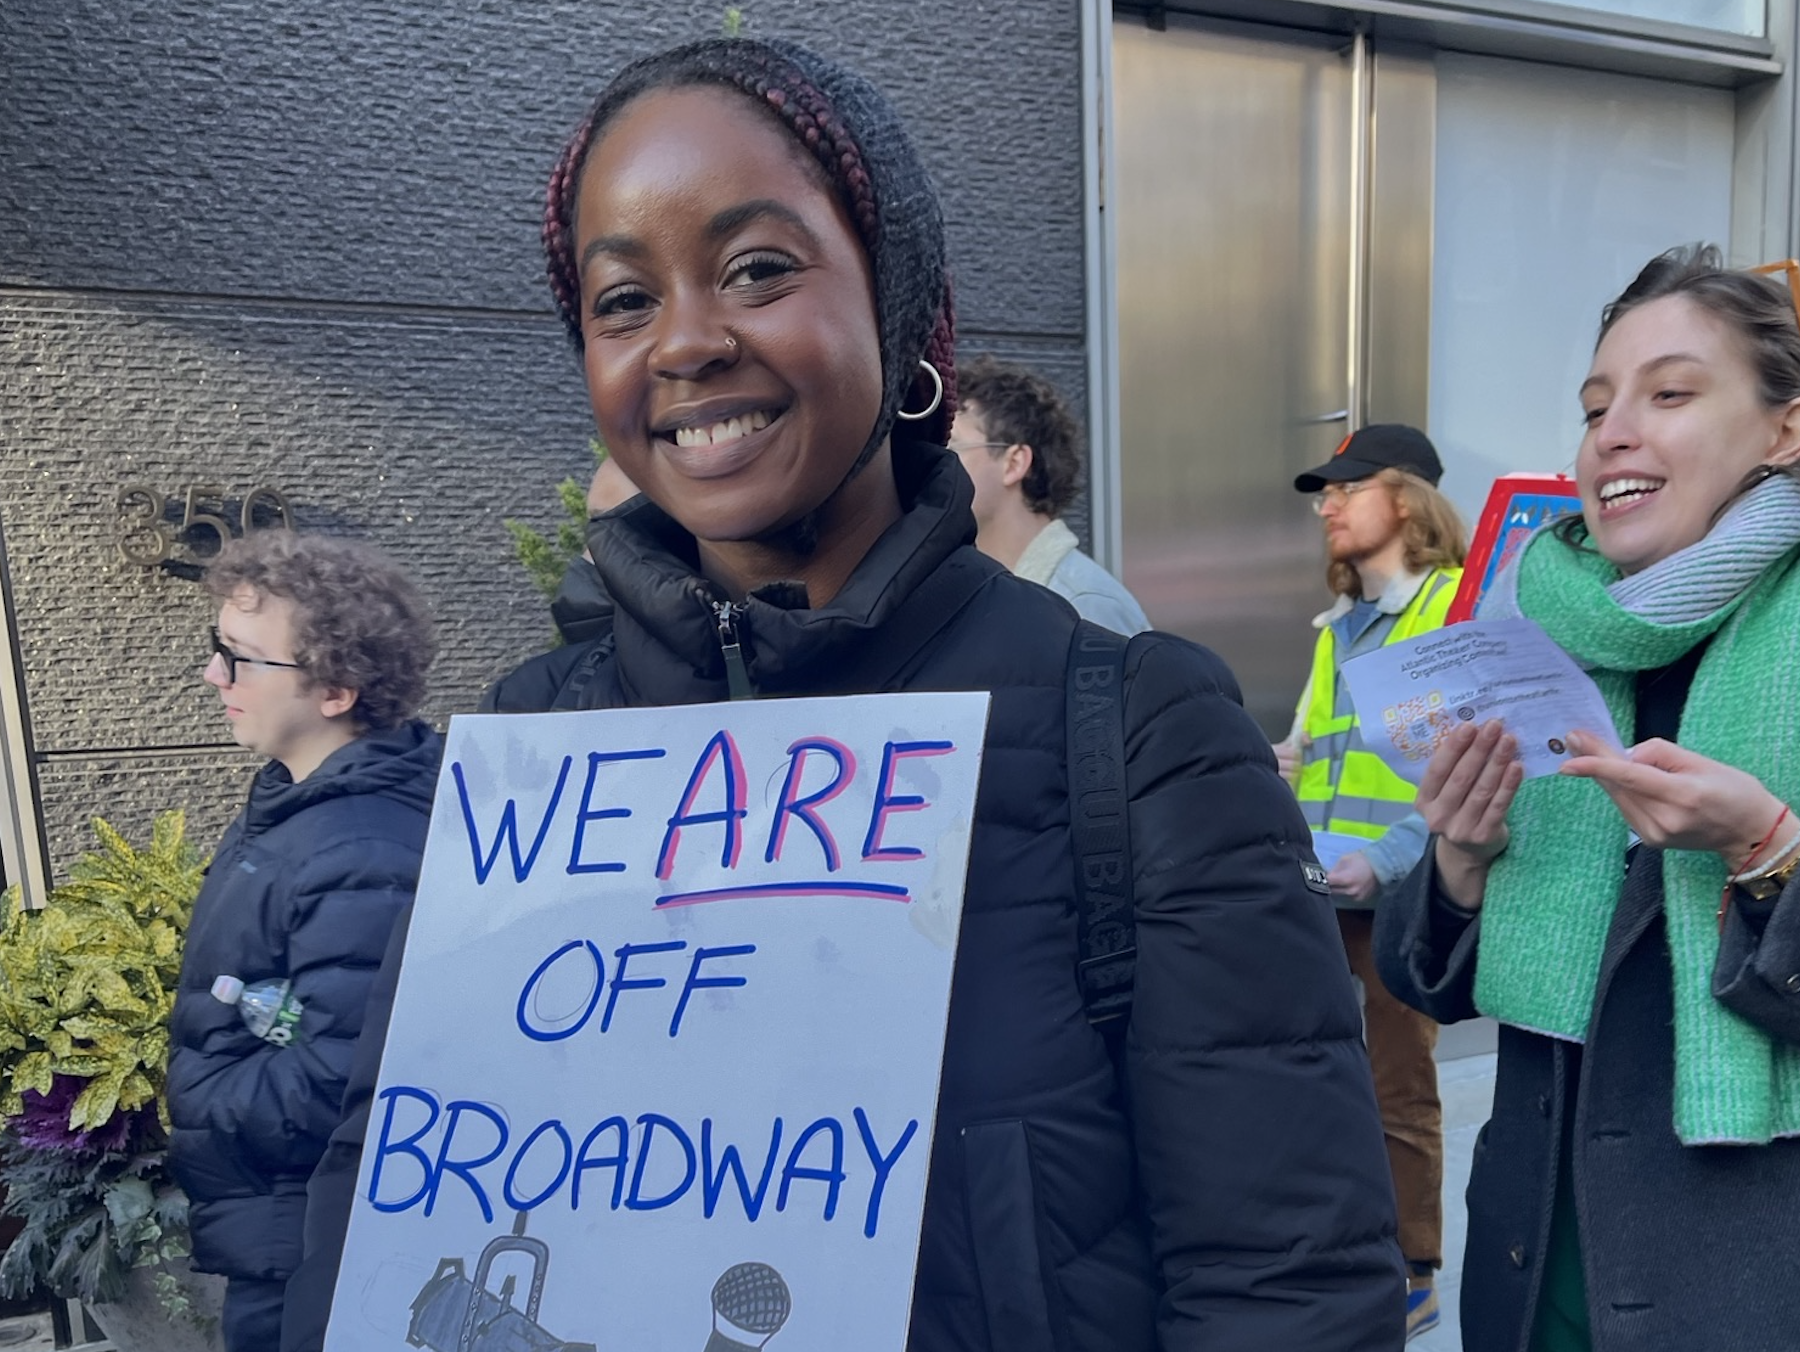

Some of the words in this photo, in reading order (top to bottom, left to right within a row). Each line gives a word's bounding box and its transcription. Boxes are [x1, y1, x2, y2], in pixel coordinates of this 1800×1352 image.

[1400, 655, 1437, 672] Atlantic
[1410, 658, 1463, 680] Organizing
[451, 747, 666, 885] WE
[654, 729, 957, 881] ARE
[1073, 665, 1122, 828] BAGGU
[516, 940, 757, 1042] OFF
[368, 1086, 919, 1239] BROADWAY
